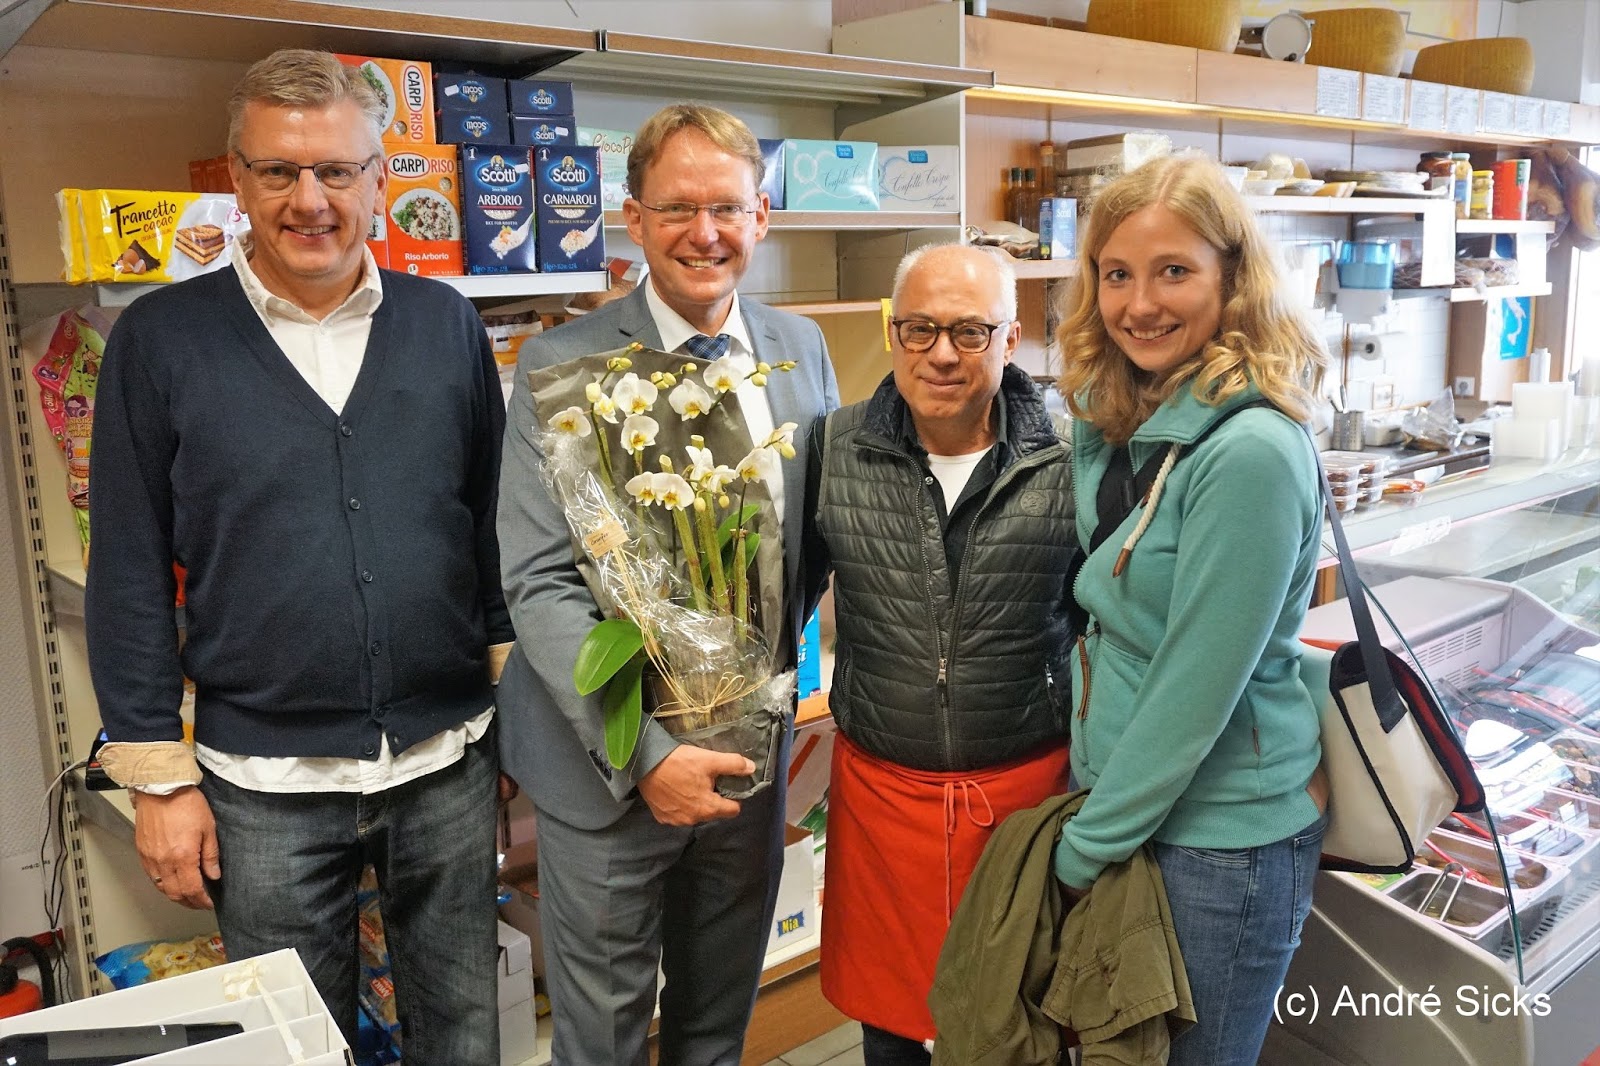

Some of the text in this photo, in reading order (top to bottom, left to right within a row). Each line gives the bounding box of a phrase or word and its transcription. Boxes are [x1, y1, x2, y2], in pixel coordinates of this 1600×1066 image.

[407, 71, 423, 140] CARPI RISO
[532, 95, 552, 106] Scotti
[534, 130, 555, 141] Scotti
[392, 158, 454, 173] CARPI RISO
[481, 168, 516, 183] Scotti
[552, 168, 586, 183] Scotti
[477, 194, 523, 206] ARBORIO
[543, 193, 597, 205] CARNAROLI
[110, 200, 177, 238] Trancetto
[143, 216, 174, 231] cacao
[404, 252, 449, 261] Riso Arborio
